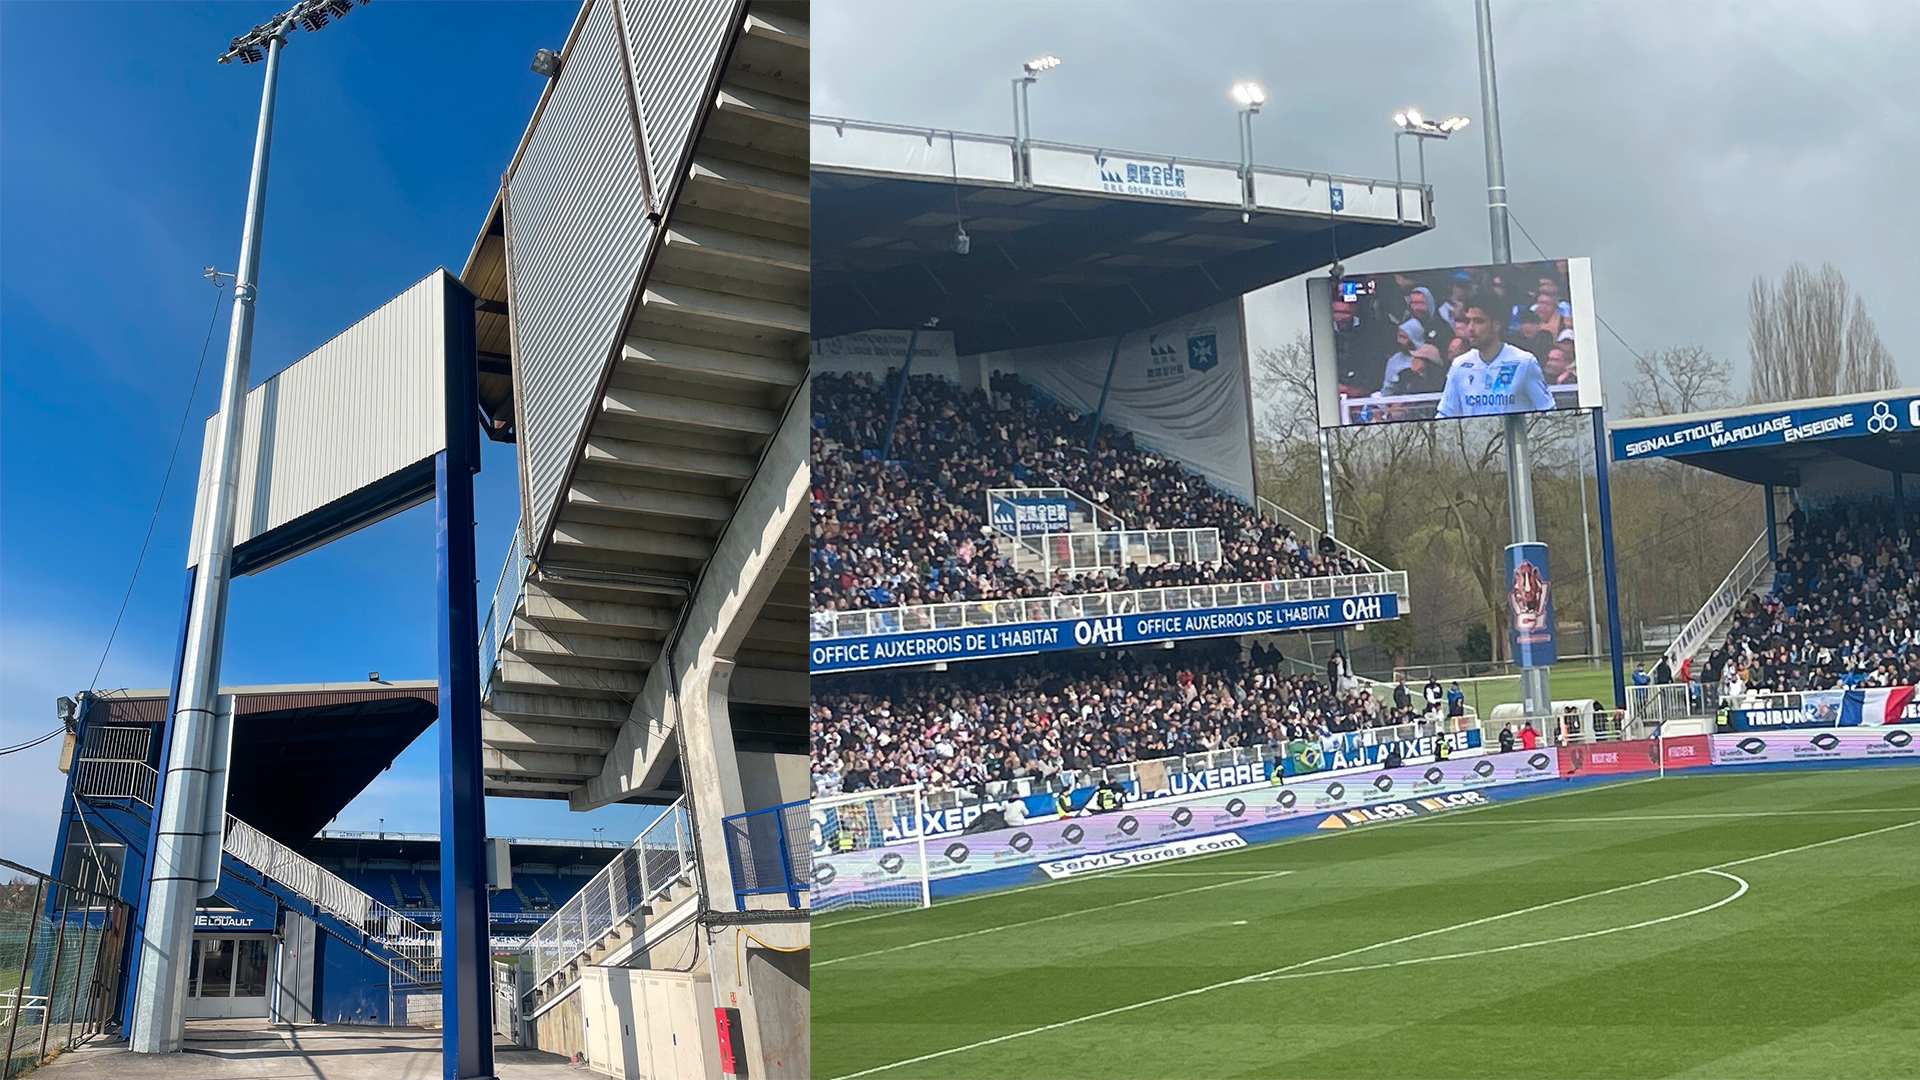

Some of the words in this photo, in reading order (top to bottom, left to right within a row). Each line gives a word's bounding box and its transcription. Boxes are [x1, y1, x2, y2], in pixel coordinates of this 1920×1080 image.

[1625, 421, 1725, 457] SIGNALETIQUE
[1710, 415, 1793, 448] MARQUAGE
[1784, 413, 1855, 442] ENSEIGNE
[813, 644, 870, 664] OFFICE
[874, 636, 962, 659] AUXERROIS
[966, 634, 986, 651] DE
[991, 627, 1059, 649] L'HABITAT
[1074, 617, 1123, 646] OAH
[1137, 617, 1182, 635] OFFICE
[1185, 611, 1254, 631] AUXERROIS
[1257, 610, 1273, 625] DE
[1276, 604, 1331, 624] L'HABITAT
[1342, 596, 1382, 621] OAH
[1154, 762, 1266, 797] UXERRE
[1364, 802, 1414, 820] LCR
[1435, 791, 1486, 807] LCR
[208, 918, 254, 926] LOUAULT
